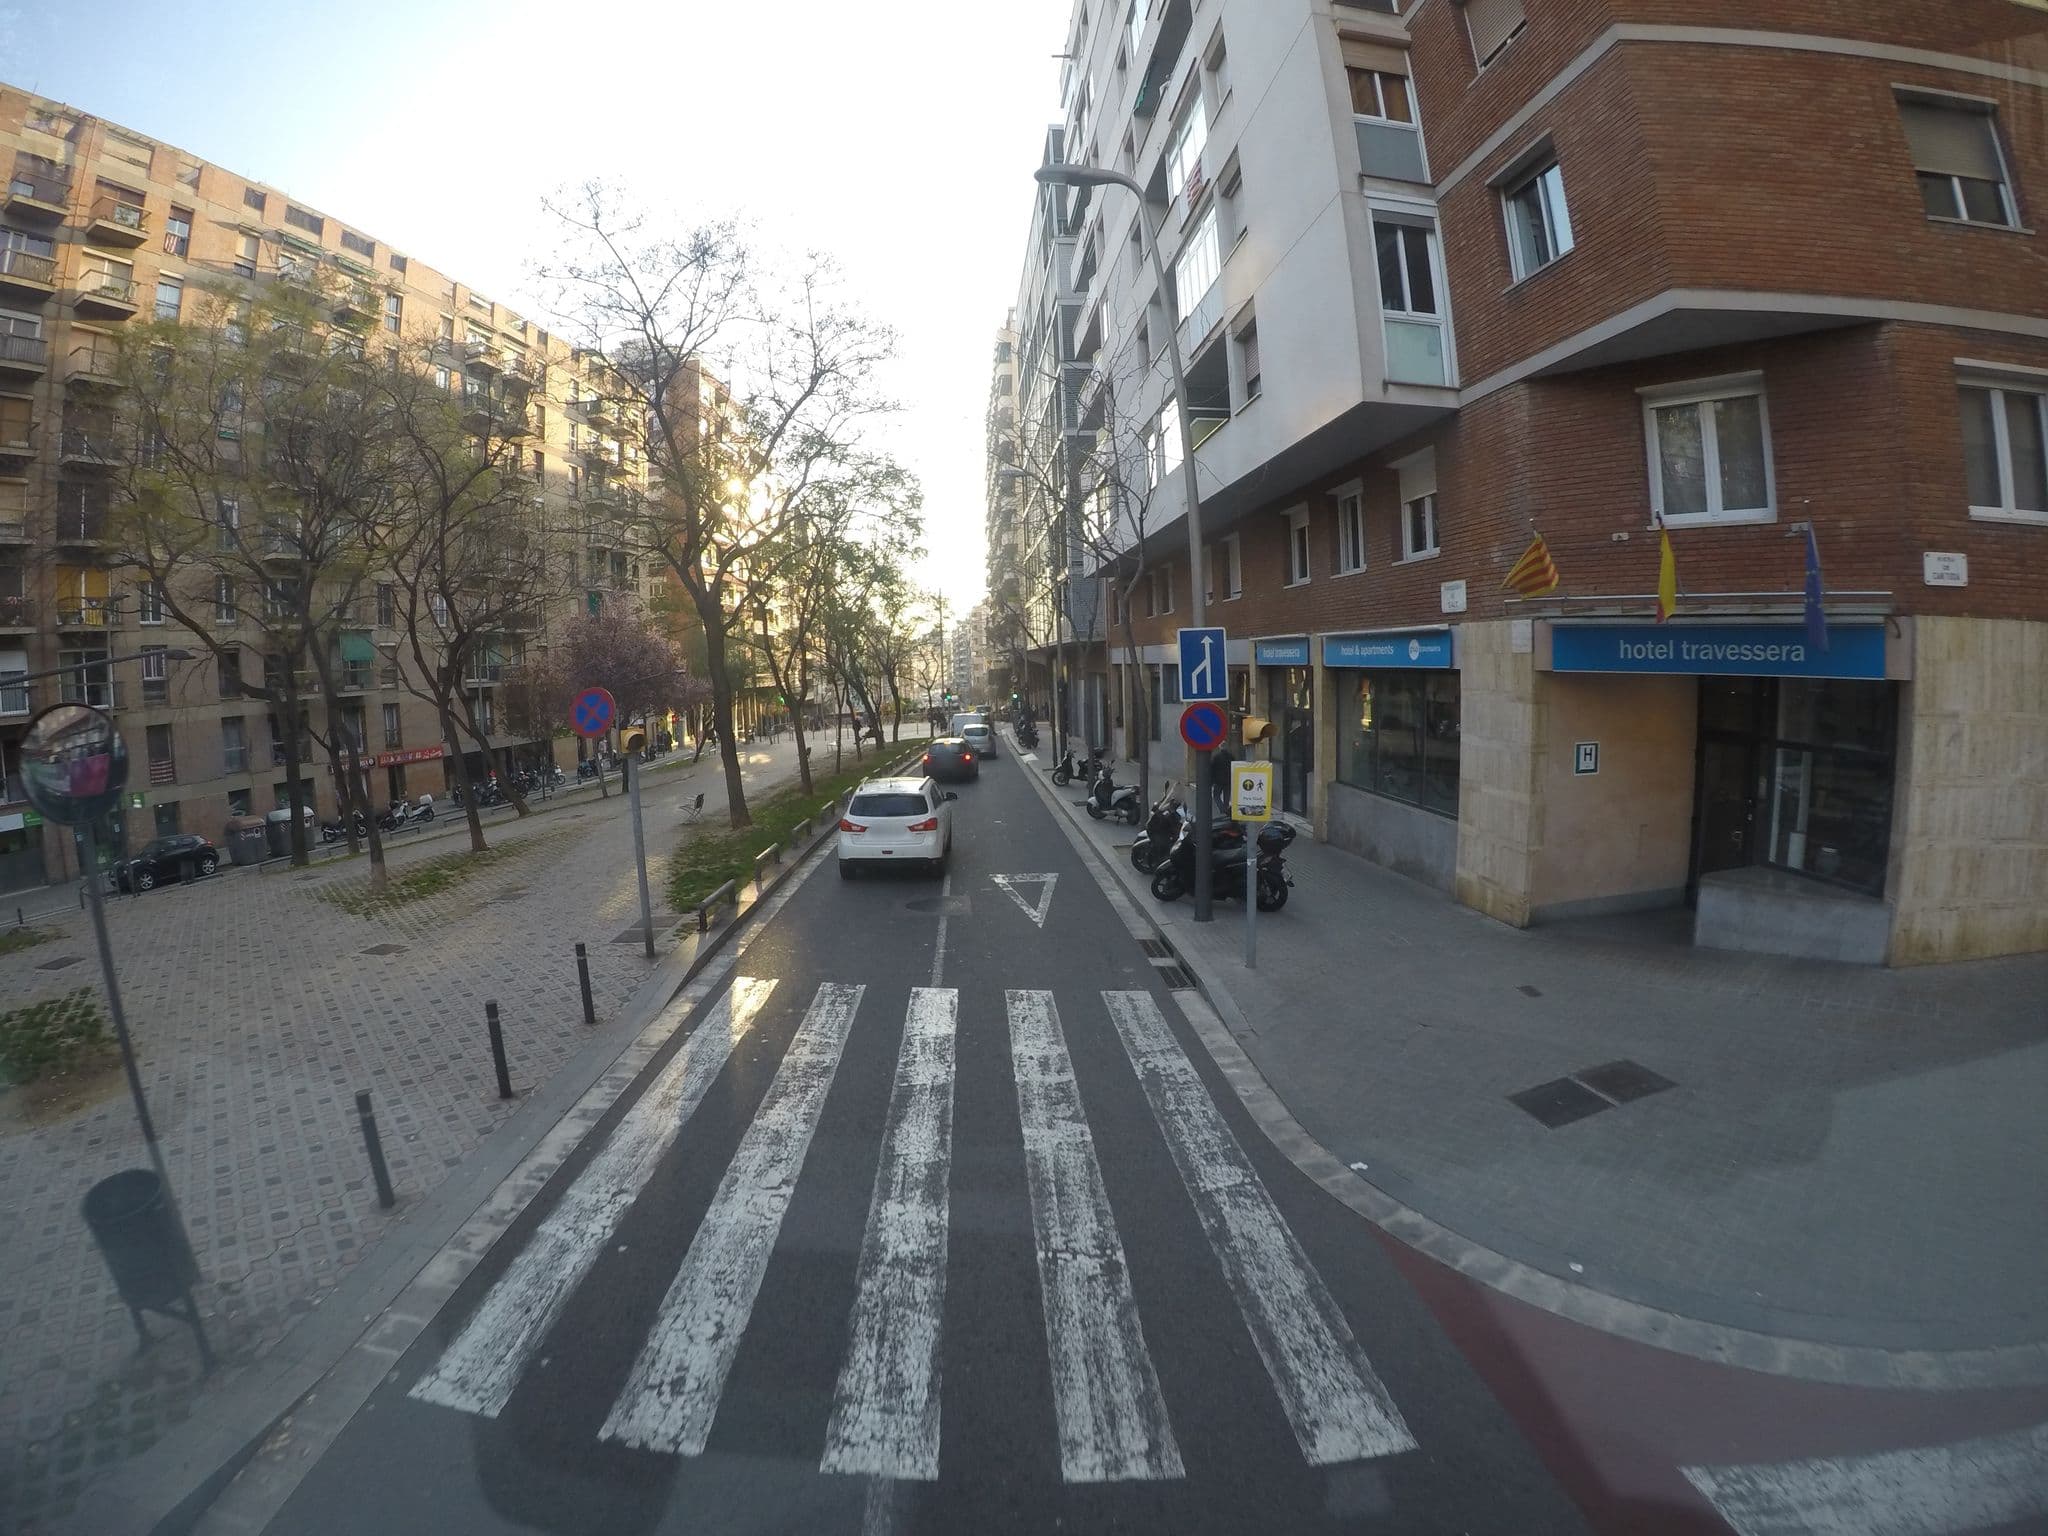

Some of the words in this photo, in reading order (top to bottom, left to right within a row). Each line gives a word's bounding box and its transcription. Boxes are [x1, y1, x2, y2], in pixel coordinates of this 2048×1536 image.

[1360, 645, 1394, 656] apartments
[1619, 639, 1674, 660] hotel
[1681, 640, 1806, 662] travessera
[1584, 747, 1593, 762] H
